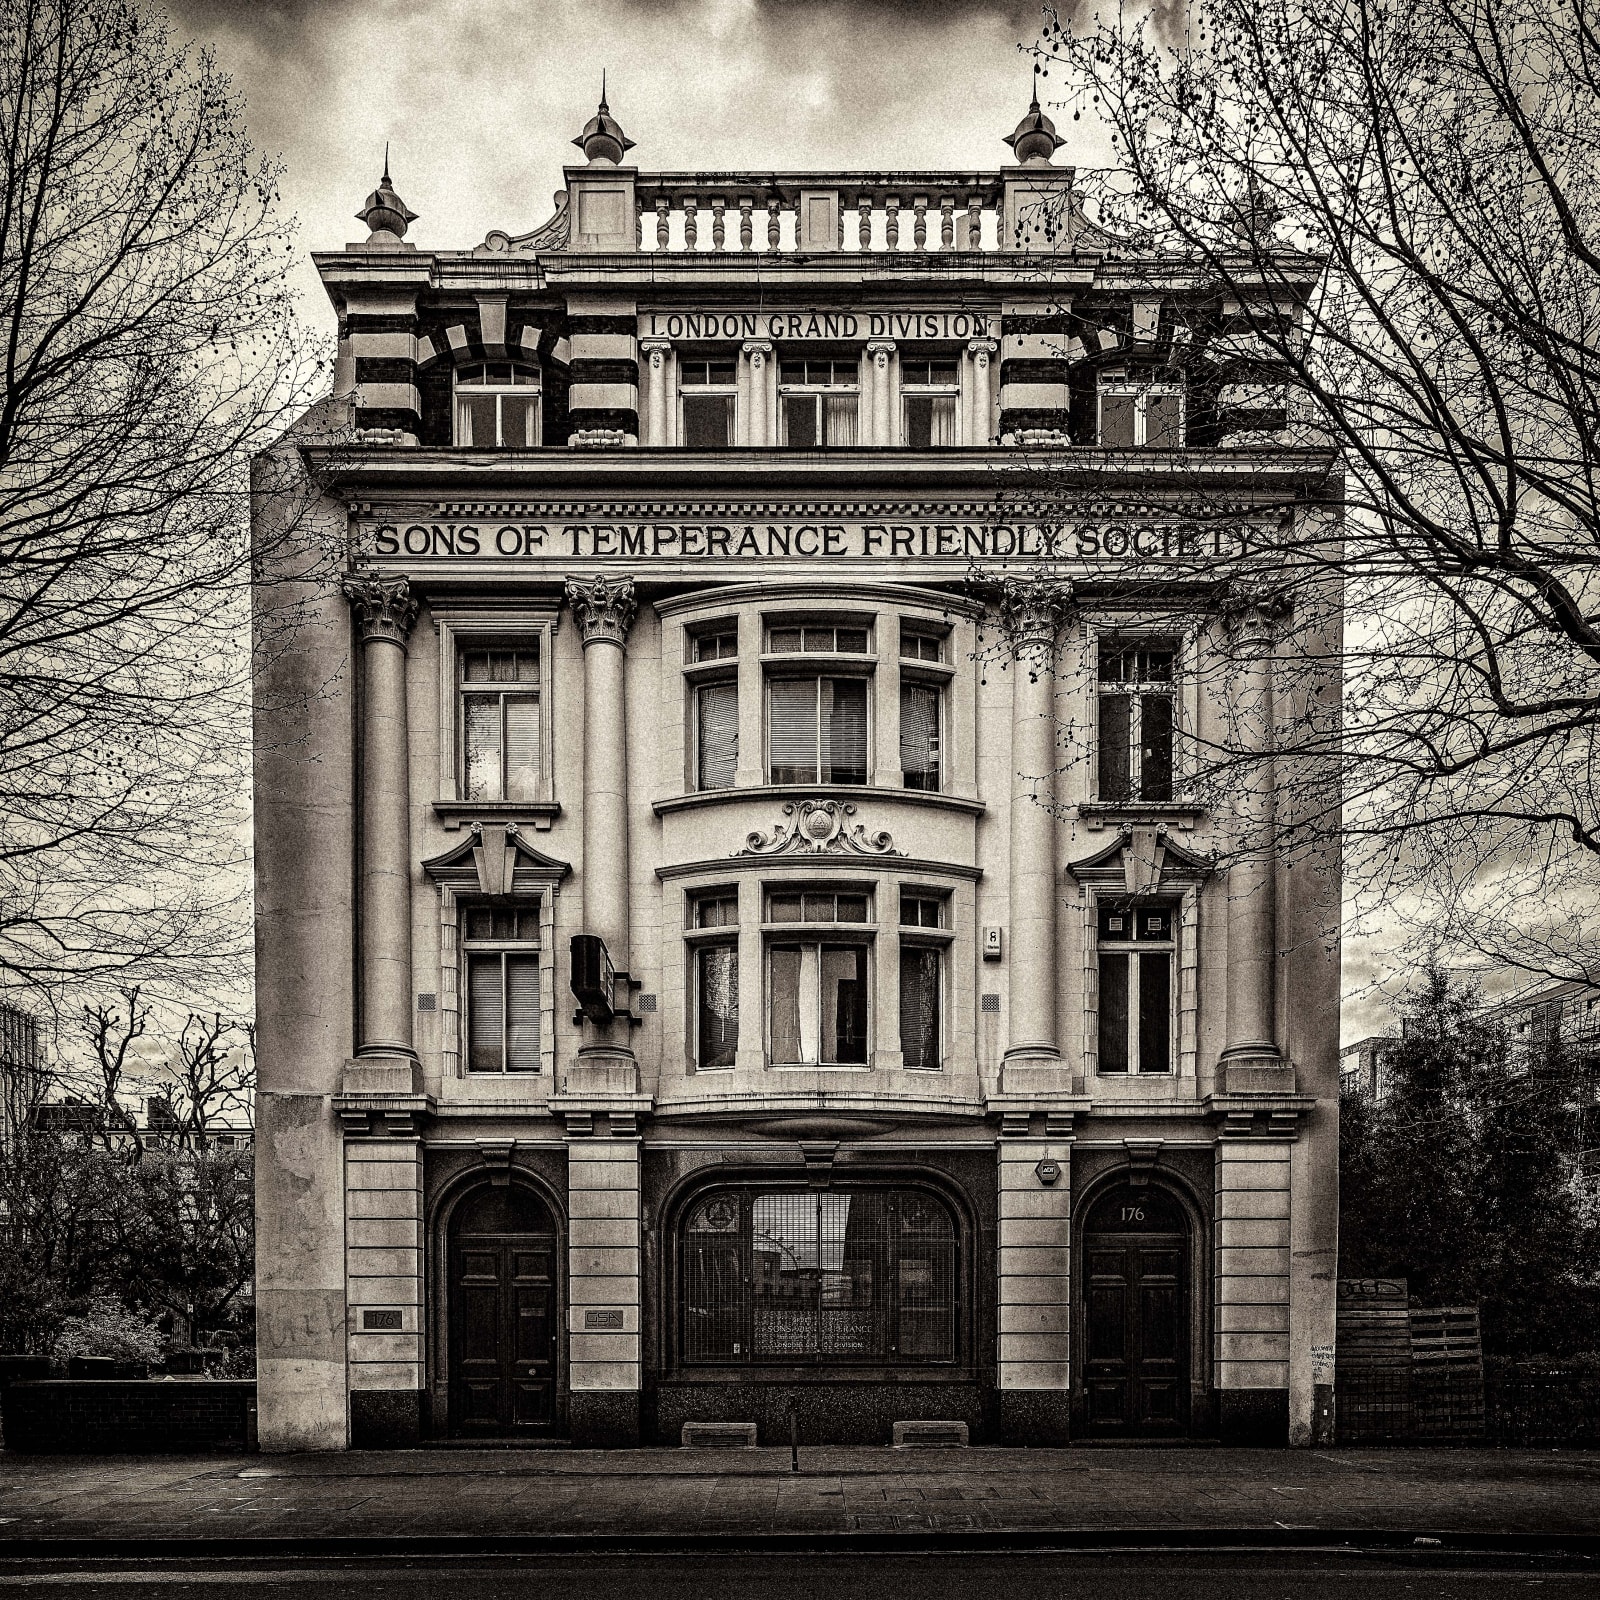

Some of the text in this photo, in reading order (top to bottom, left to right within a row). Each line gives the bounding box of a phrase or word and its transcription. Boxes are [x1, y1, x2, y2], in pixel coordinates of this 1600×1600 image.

[650, 314, 989, 339] LONDON GRAND DIVISION
[375, 524, 1257, 557] SONS OF TEMPERANCE FRIENDLY SOCIETY
[1121, 1207, 1145, 1221] 176
[374, 1312, 394, 1326] 176
[586, 1312, 621, 1323] GSA
